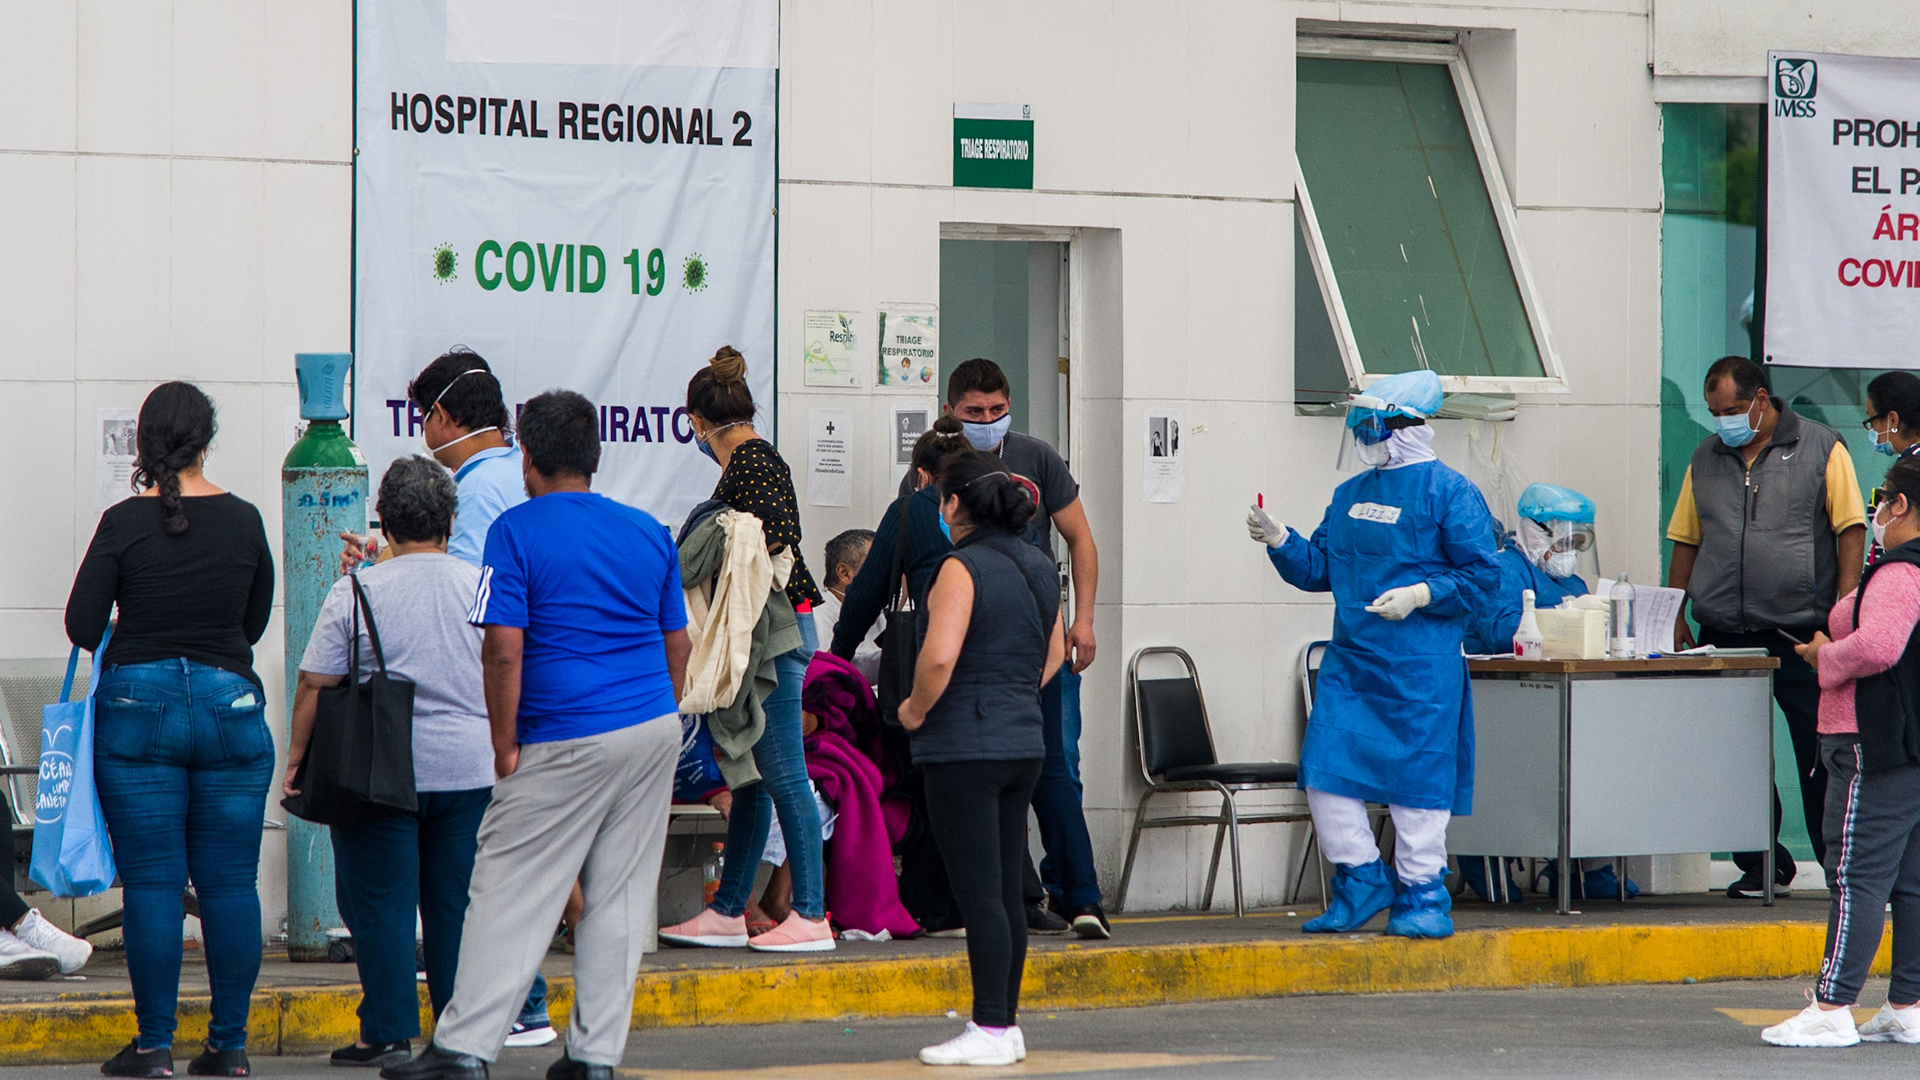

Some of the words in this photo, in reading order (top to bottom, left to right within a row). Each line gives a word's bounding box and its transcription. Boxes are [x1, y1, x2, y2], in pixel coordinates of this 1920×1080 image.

[391, 91, 548, 139] HOSPITAL
[558, 101, 723, 146] REGIONAL
[731, 110, 753, 147] 2
[1774, 99, 1816, 118] IMSS
[1832, 118, 1920, 148] PROH
[960, 138, 983, 159] TRIAGE
[984, 138, 1029, 160] RESPIRATORIO
[1851, 166, 1891, 194] EL
[1900, 168, 1920, 195] P
[1872, 203, 1919, 241] ÁR
[474, 239, 606, 294] COVID
[623, 247, 666, 297] 19
[1837, 257, 1920, 288] COVI
[896, 335, 922, 345] TRIAGE
[883, 347, 934, 358] RESPIRATORIO
[38, 757, 73, 781] CÉAN
[52, 779, 71, 795] LIMP
[36, 792, 67, 810] LANETA
